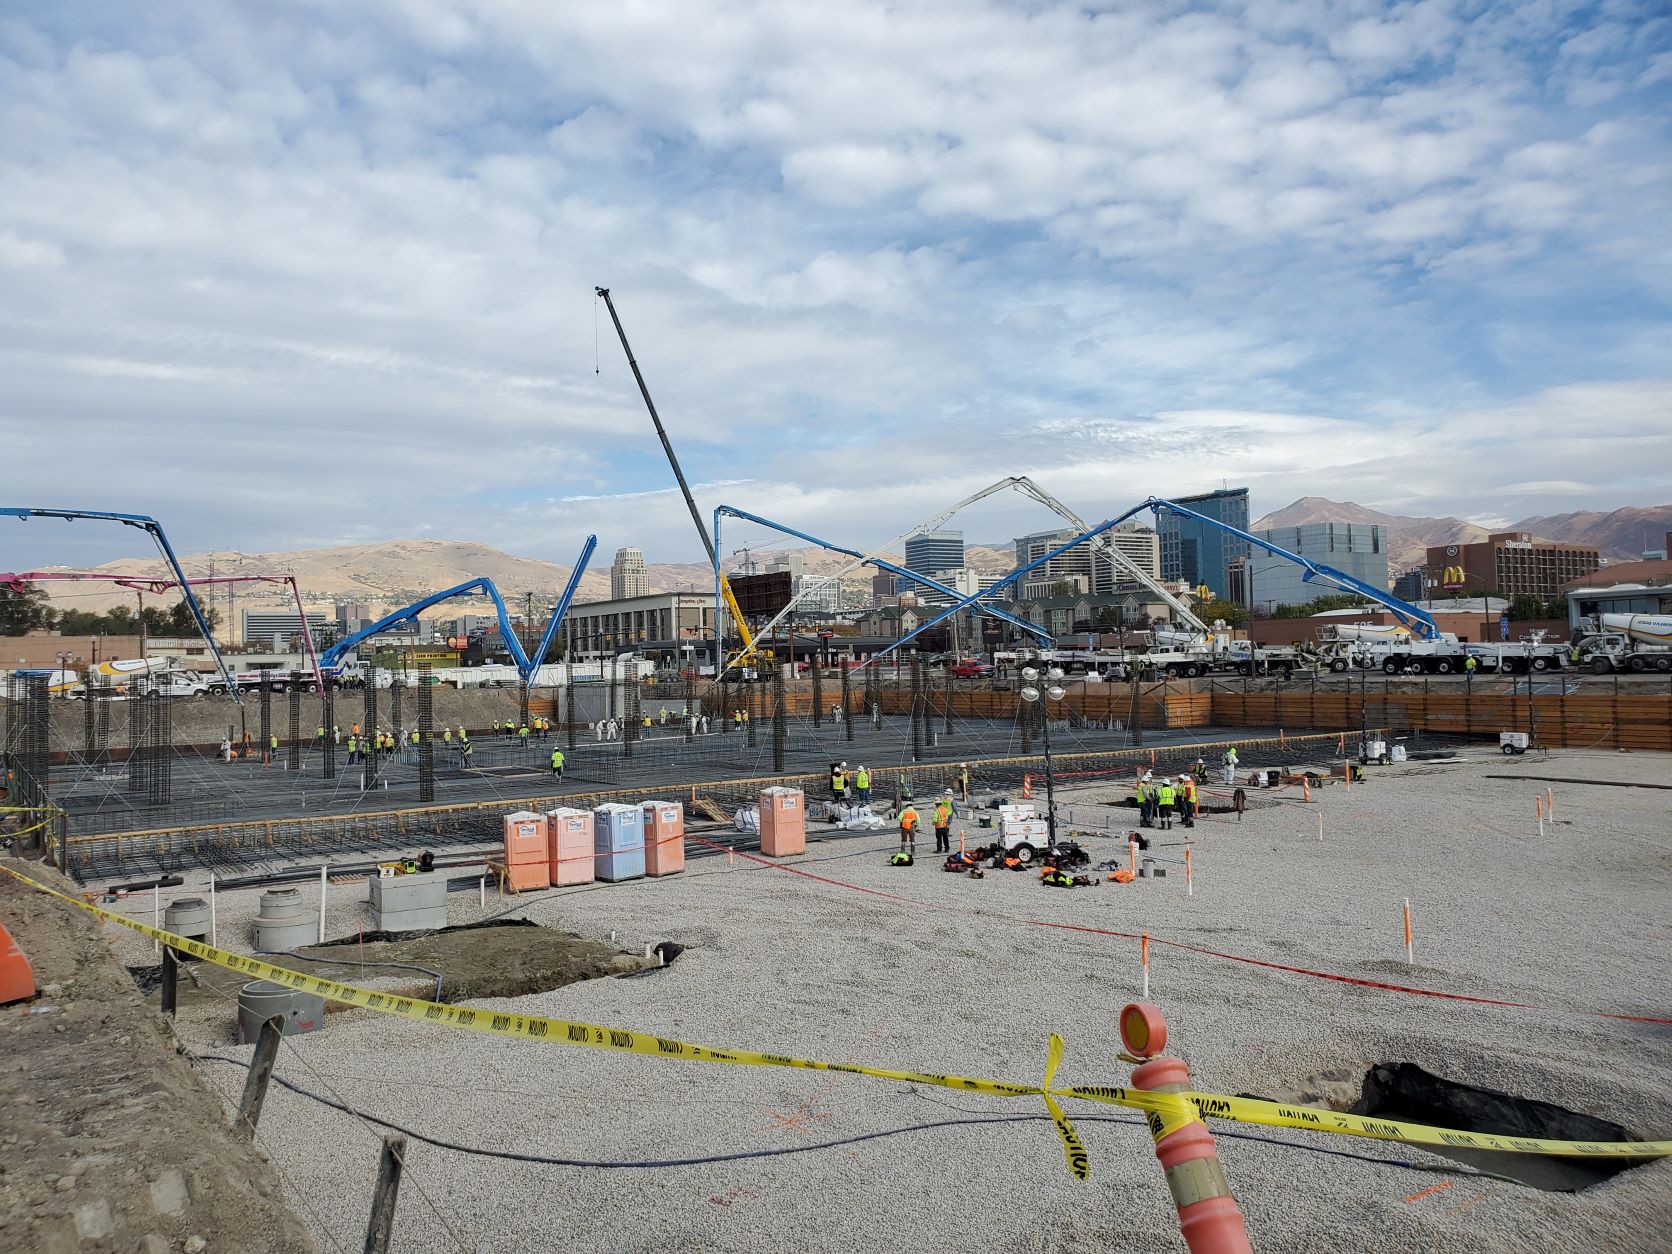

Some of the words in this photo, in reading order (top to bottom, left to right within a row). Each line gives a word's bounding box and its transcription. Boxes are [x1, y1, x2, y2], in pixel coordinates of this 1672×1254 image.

[424, 1004, 443, 1020] CAUTION
[456, 1010, 475, 1026] CAUTION
[490, 1015, 511, 1031] CAUTION
[527, 1020, 548, 1037] CAUTION
[567, 1025, 588, 1043] CAUTION
[608, 1031, 634, 1049] CAUTION
